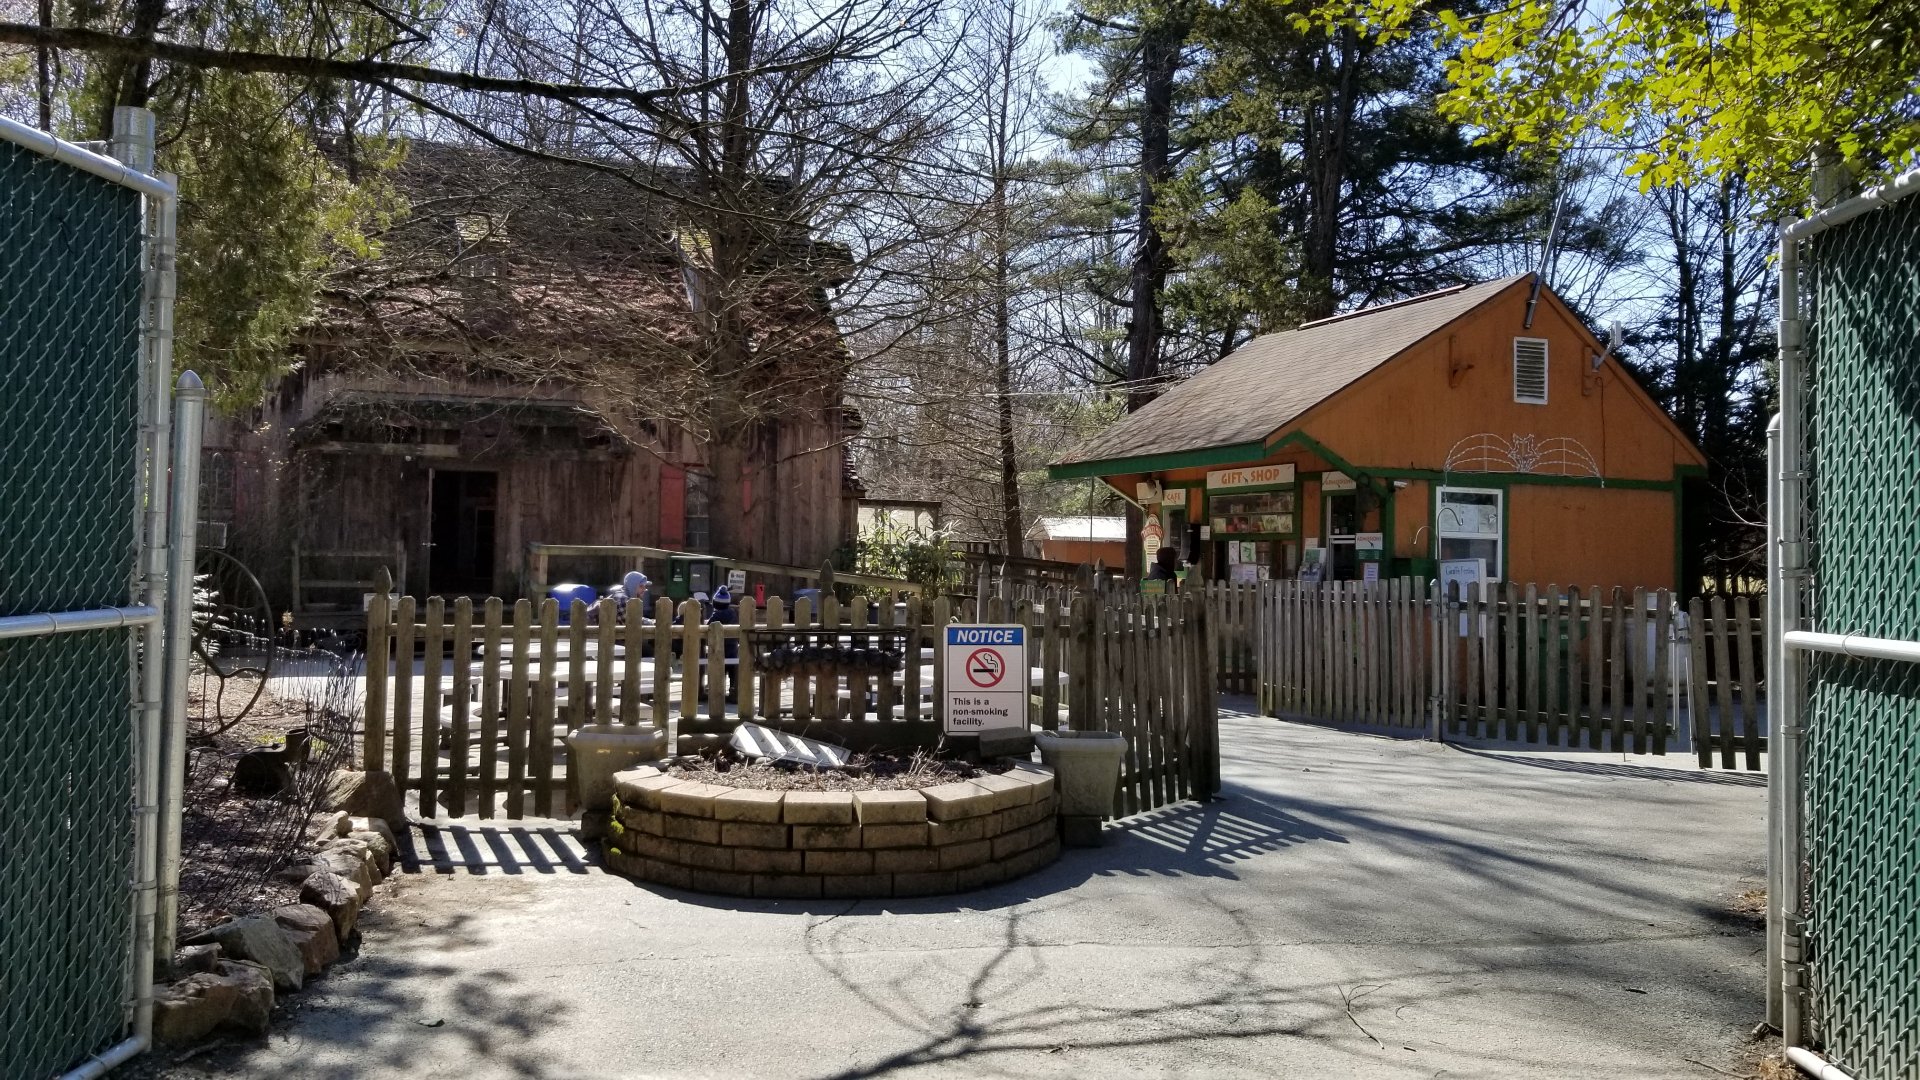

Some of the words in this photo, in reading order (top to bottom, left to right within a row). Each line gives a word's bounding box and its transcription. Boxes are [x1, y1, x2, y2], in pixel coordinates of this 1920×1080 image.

[1221, 471, 1243, 485] GIFT
[1250, 468, 1280, 482] SHOP
[957, 629, 1014, 643] NOTICE
[953, 697, 971, 706] This
[973, 697, 982, 706] is
[953, 707, 1009, 717] non-smoking
[953, 717, 985, 727] facility.
